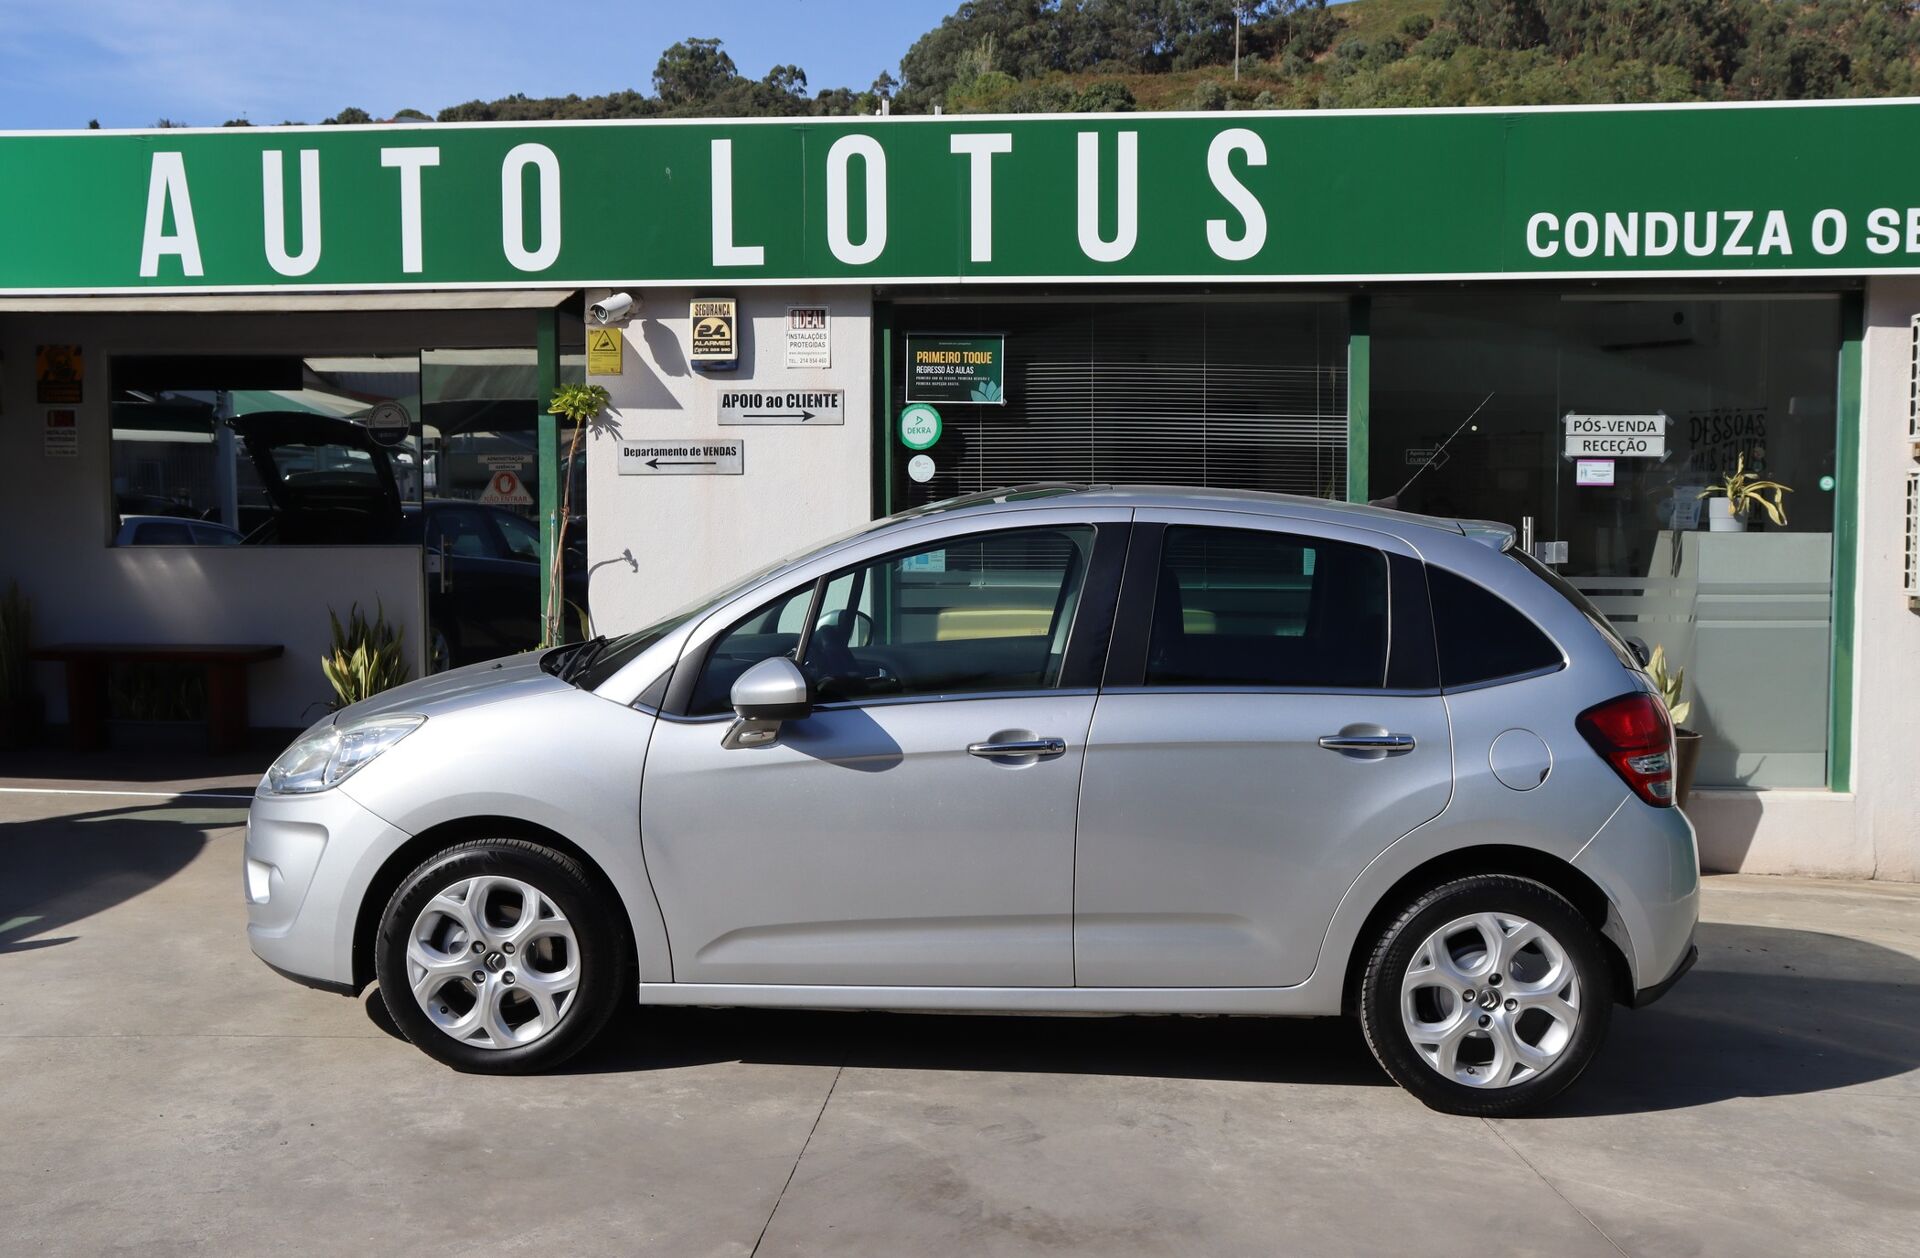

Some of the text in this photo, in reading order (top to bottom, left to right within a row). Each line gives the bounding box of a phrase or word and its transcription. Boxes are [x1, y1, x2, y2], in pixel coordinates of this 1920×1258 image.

[139, 128, 1267, 277] AUTO LOTUS
[1527, 210, 1792, 258] CONDUZA
[1811, 208, 1848, 255] O
[697, 324, 726, 338] 24
[788, 332, 827, 341] INSTALAÇÕES
[917, 351, 992, 364] PRIMEIRO TOQUE
[916, 364, 974, 375] REGRESSO ÀS AULAS
[722, 393, 838, 408] APOIO ao CLIENTE
[1573, 417, 1657, 432] PÓS-VENDA
[1689, 414, 1766, 449] PESSOAS
[623, 447, 737, 459] Departamento de VENDAS
[1582, 437, 1647, 454] RECEÇÃO
